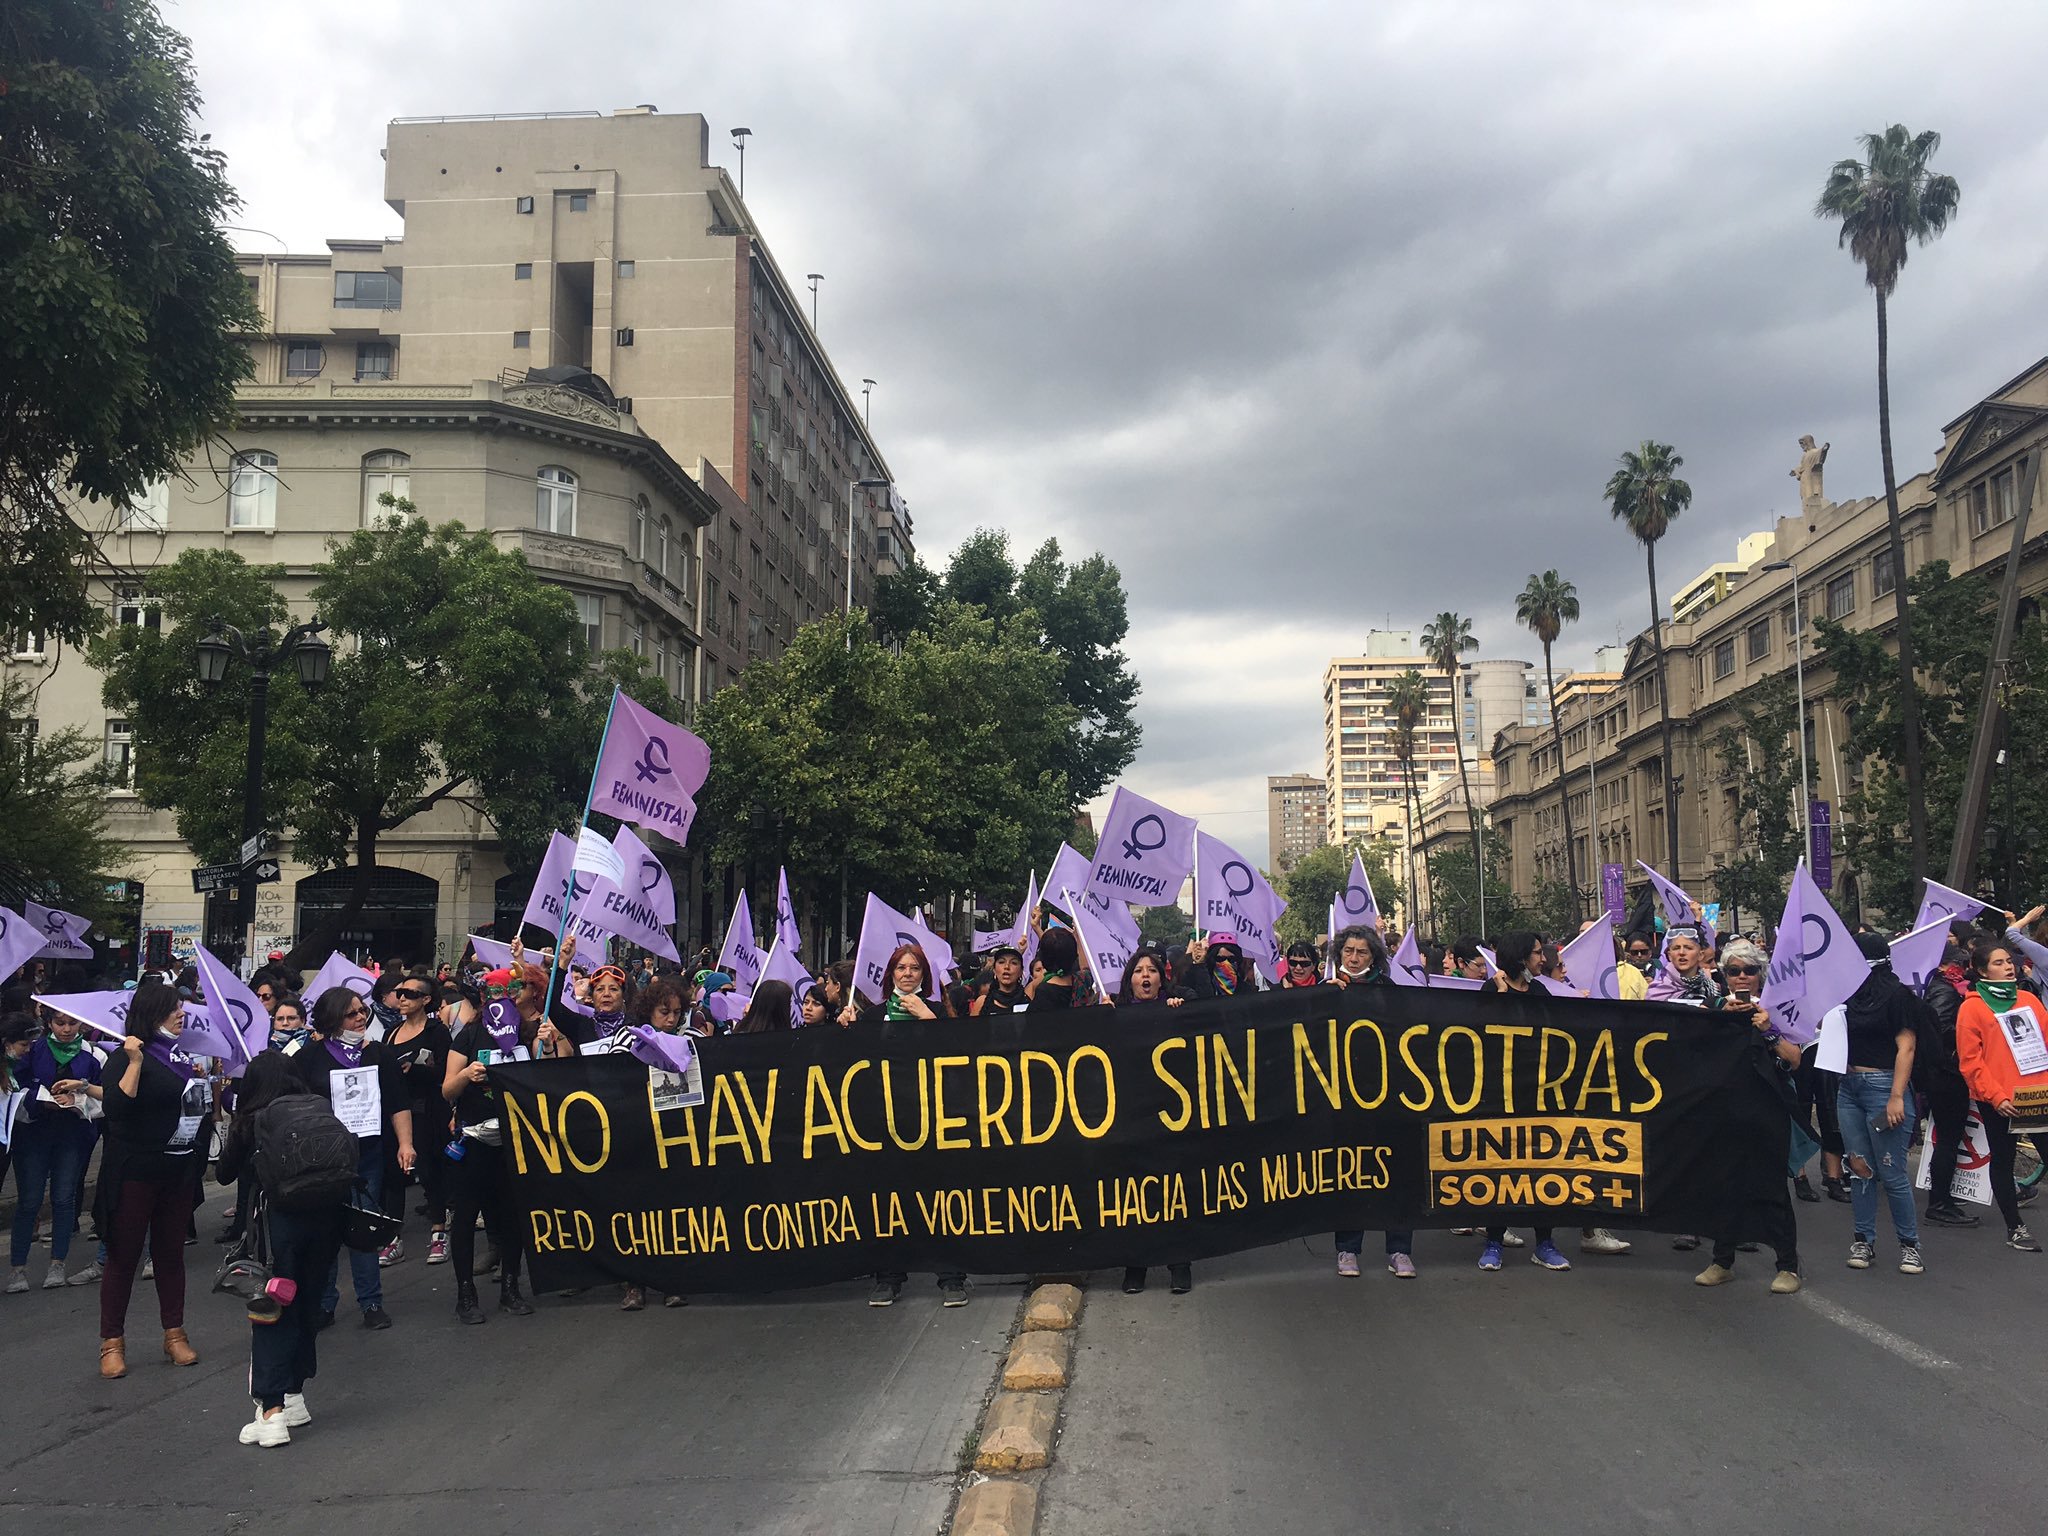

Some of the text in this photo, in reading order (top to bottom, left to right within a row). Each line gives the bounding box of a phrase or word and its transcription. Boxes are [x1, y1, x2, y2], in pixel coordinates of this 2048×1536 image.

[612, 780, 688, 828] FEMINISTA!
[197, 867, 224, 876] VICTORIA
[1096, 864, 1167, 897] FEMINISTA!
[256, 905, 284, 918] AFP
[503, 1090, 611, 1174] NO
[647, 1068, 779, 1169] HAY
[802, 1045, 1116, 1159] ACUERDO
[1151, 1028, 1256, 1132] SIN
[1292, 1019, 1669, 1115] NOSOTRAS
[1442, 1125, 1629, 1163] UNIDAS
[530, 1145, 1392, 1256] RED CHILENA CONTRA LA VIOLENCIA HACIA LAS MUJERES
